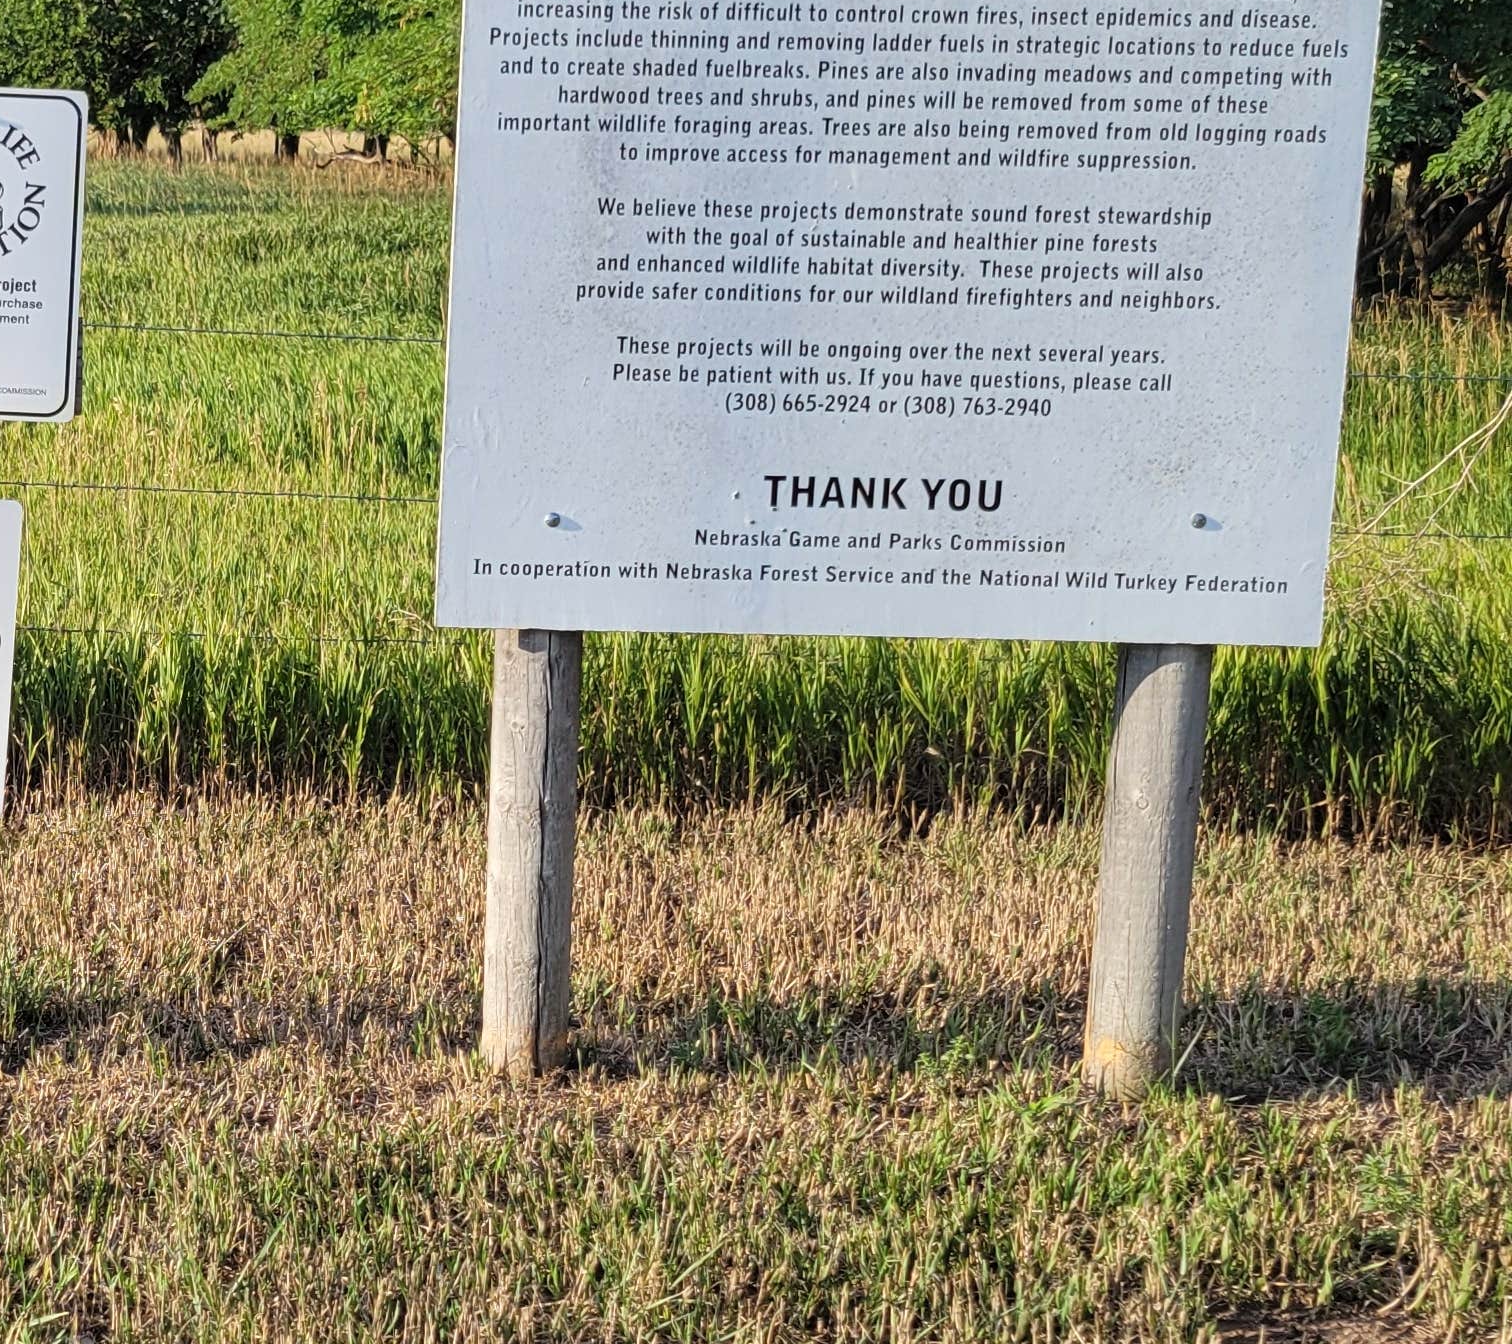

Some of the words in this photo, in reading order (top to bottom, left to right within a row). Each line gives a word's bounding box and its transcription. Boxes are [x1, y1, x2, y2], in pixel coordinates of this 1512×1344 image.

[597, 197, 625, 216] We
[632, 197, 696, 218] believe
[703, 199, 753, 219] these
[760, 200, 837, 223] projects
[844, 201, 963, 222] demonstrate
[971, 204, 1028, 223] sound
[1035, 204, 1091, 224] forest
[1098, 206, 1212, 230] stewardship
[725, 392, 776, 415] (308)
[782, 393, 871, 413] 665-2924
[878, 399, 898, 414] or
[903, 395, 955, 418] (308)
[962, 397, 1052, 417] 763-2940
[763, 475, 908, 512] THANK
[921, 478, 1003, 512] YOU
[695, 529, 782, 549] Nebraska
[788, 530, 842, 549] Game
[847, 532, 883, 550] and
[889, 532, 943, 552] Parks
[950, 533, 1067, 554] Commission
[473, 558, 492, 575] In
[499, 560, 611, 580] cooperation
[618, 561, 658, 579] with
[666, 562, 753, 581] Nebraska
[759, 564, 818, 582] Forest
[825, 565, 894, 584] Service
[900, 568, 937, 585] and
[941, 568, 971, 586] the
[979, 569, 1060, 588] National
[1065, 571, 1108, 589] Wild
[1114, 572, 1178, 594] Turkey
[1185, 574, 1288, 594] Federation
